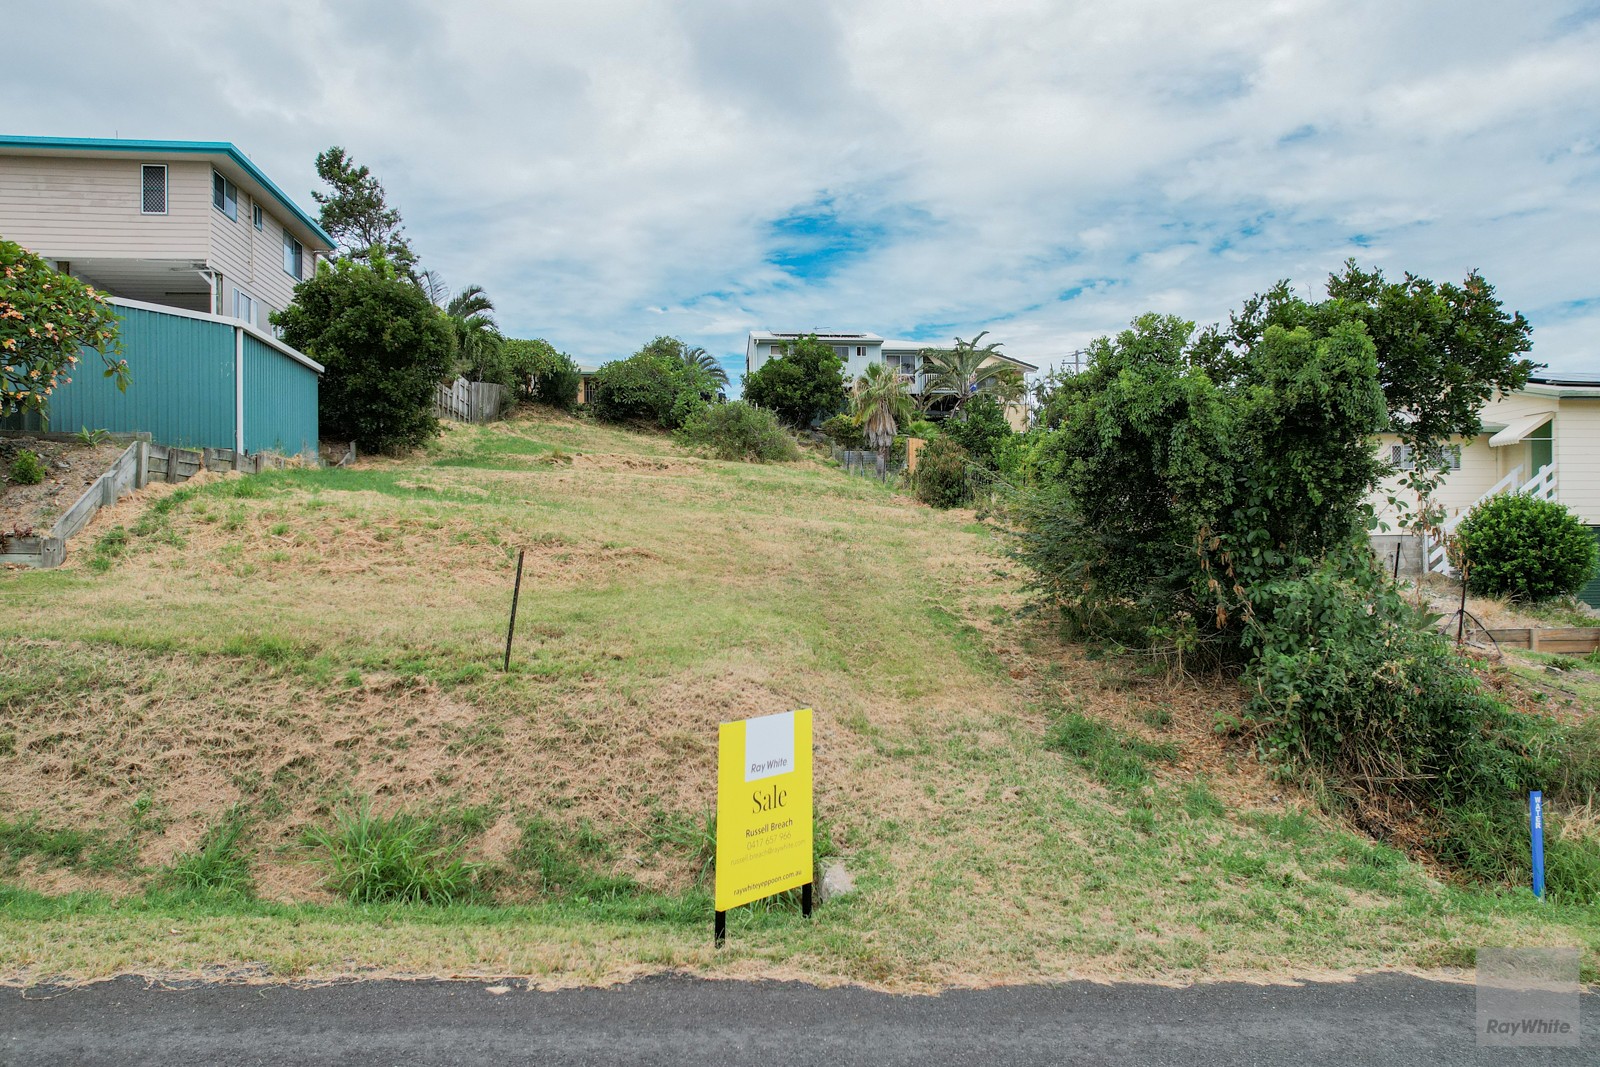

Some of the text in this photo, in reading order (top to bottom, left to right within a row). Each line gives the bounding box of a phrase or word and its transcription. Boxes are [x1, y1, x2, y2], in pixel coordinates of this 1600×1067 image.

[751, 758, 788, 773] Ray White
[752, 784, 787, 814] Sale
[745, 818, 793, 838] Russell Breach
[733, 869, 802, 896] raywhiteyeppoon.com.au
